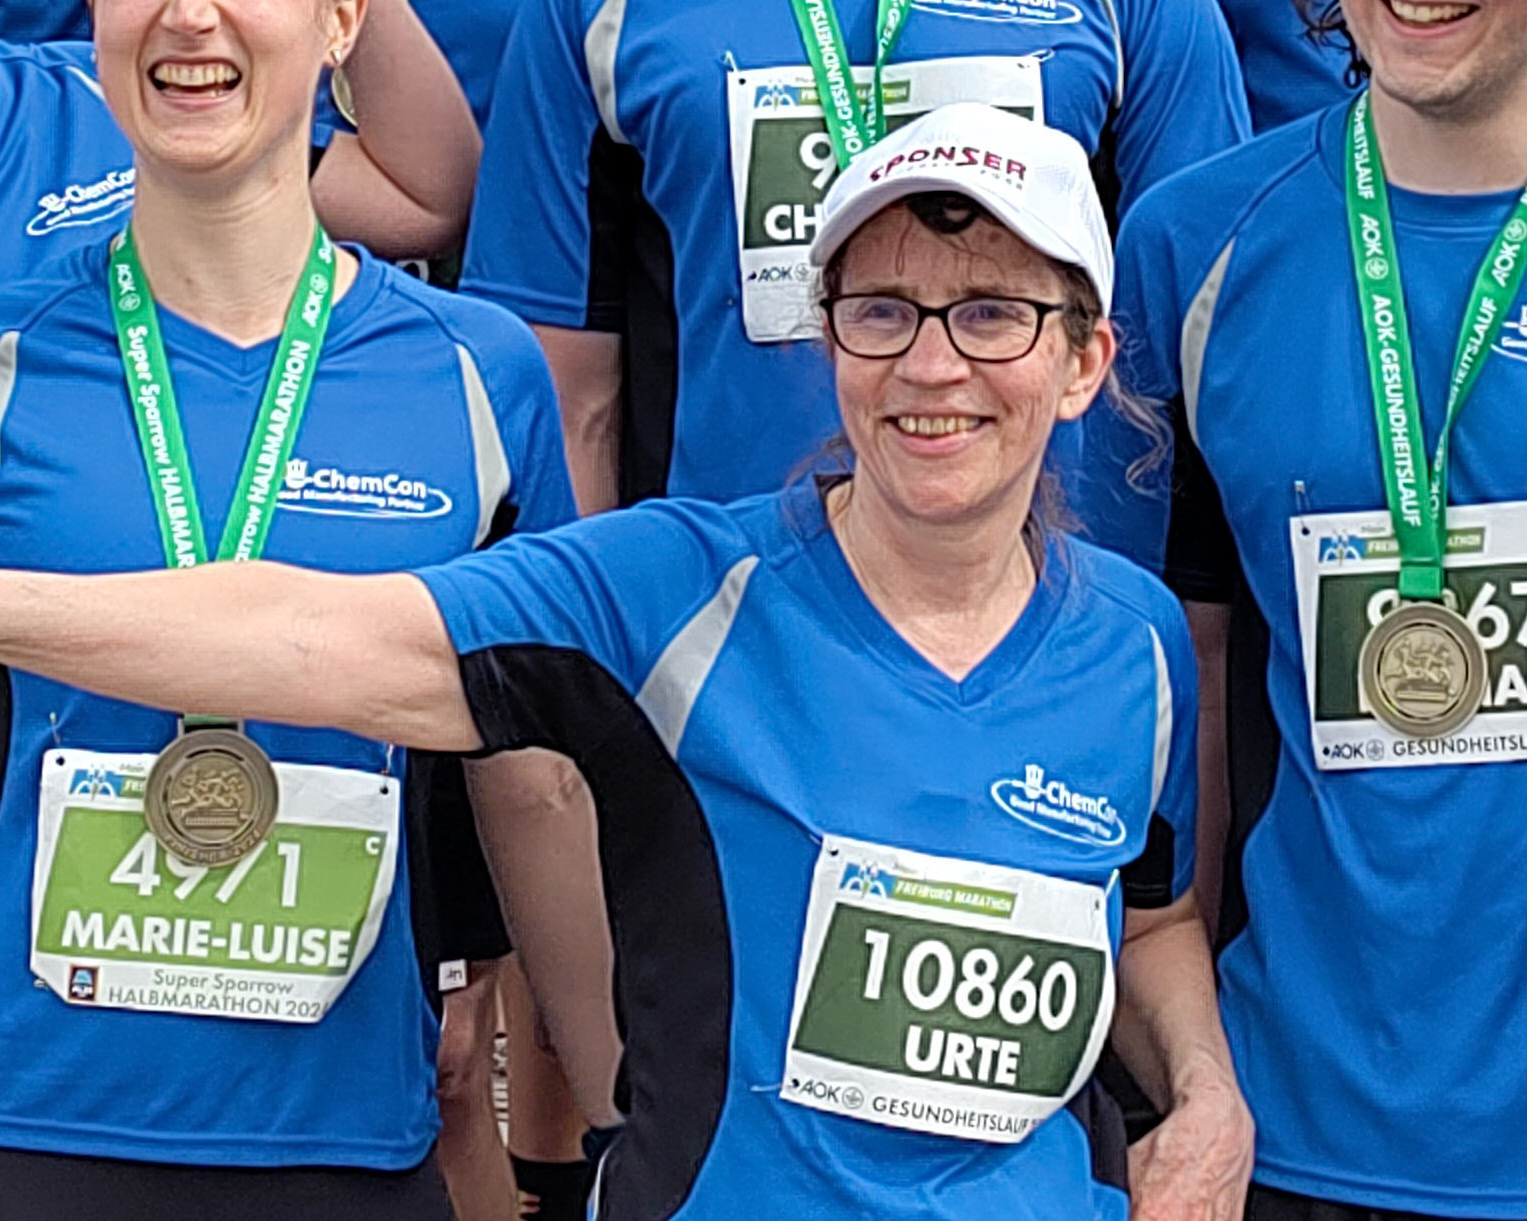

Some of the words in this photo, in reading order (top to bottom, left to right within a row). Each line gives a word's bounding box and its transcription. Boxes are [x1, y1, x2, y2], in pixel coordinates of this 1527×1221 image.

[1359, 213, 1385, 257] AOK
[115, 263, 136, 295] AOK
[1490, 241, 1521, 288] AOK
[300, 294, 323, 328] AOK
[127, 325, 152, 380] Super
[138, 383, 171, 466] Sparrow
[246, 340, 310, 505] HALBMARATHON
[1371, 292, 1421, 528] AOK-GESUNDHEITSLAUF
[312, 468, 427, 499] ChemCon
[233, 504, 262, 564] arrow
[61, 910, 352, 969] MARIE-LUISE
[109, 985, 280, 1016] HALBMARATHON
[154, 969, 208, 990] Super
[214, 973, 295, 996] Sparrow
[863, 928, 1079, 1033] 10860
[904, 1024, 1022, 1087] URTE
[800, 1079, 840, 1104] AOK
[872, 1095, 1030, 1136] GESUNDHEITSLAUF
